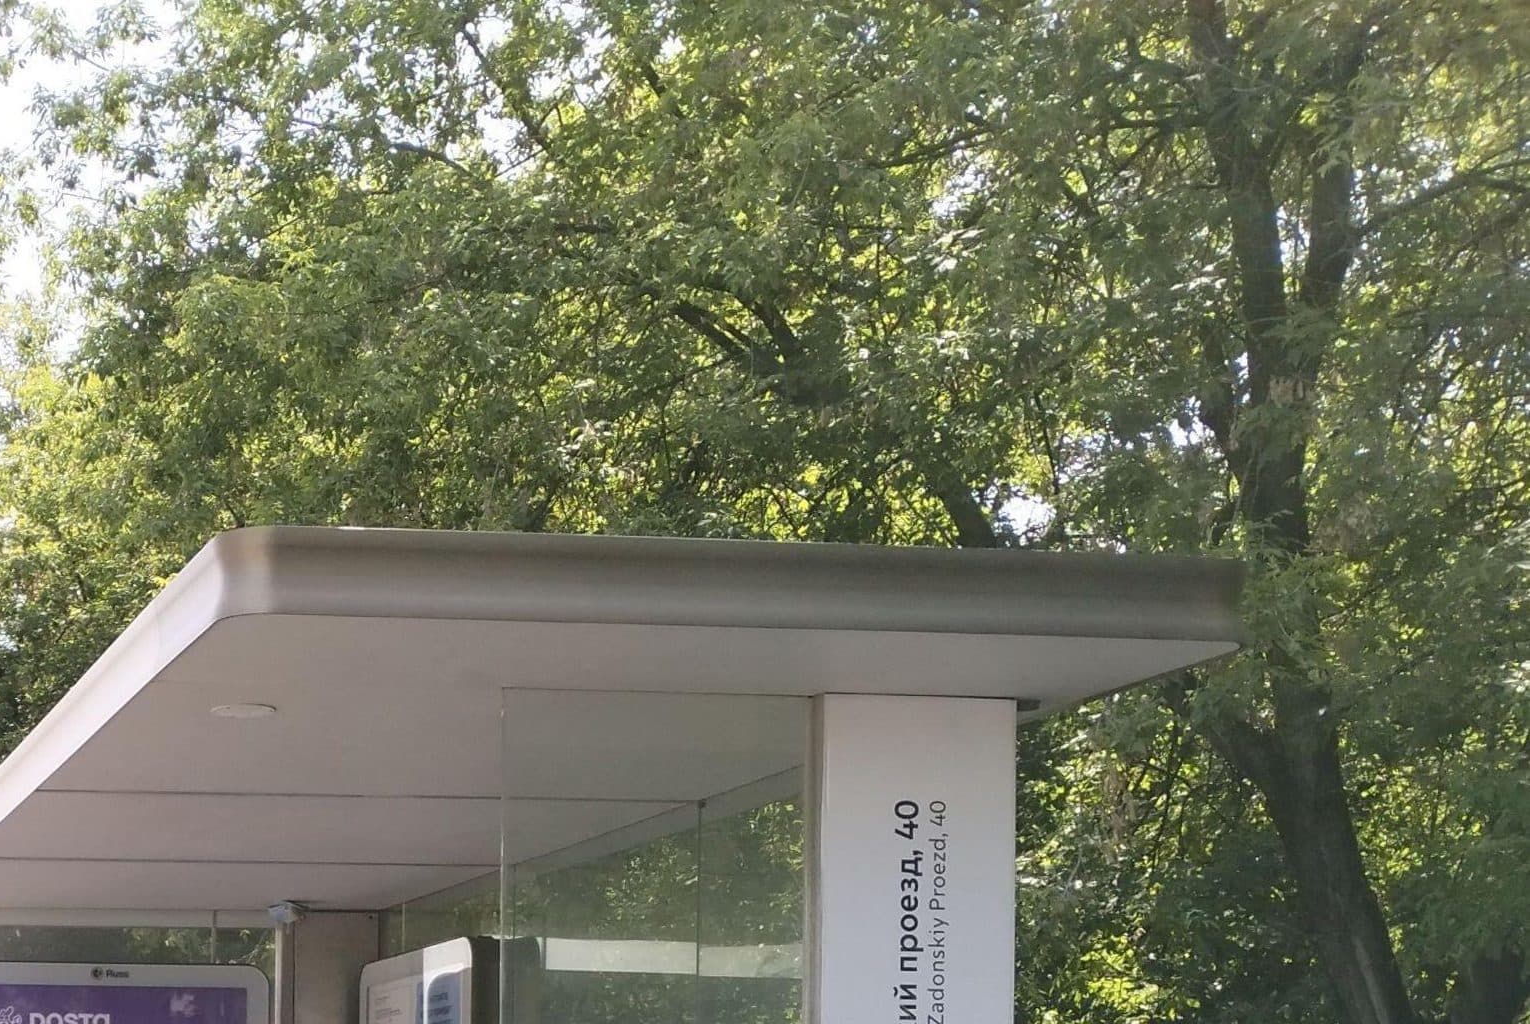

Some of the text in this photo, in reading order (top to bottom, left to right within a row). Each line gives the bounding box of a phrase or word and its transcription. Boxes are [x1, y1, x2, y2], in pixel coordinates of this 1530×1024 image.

[894, 800, 920, 840] 40
[929, 800, 947, 827] 40
[928, 834, 949, 911] Proezd,
[900, 850, 924, 972] проезд,
